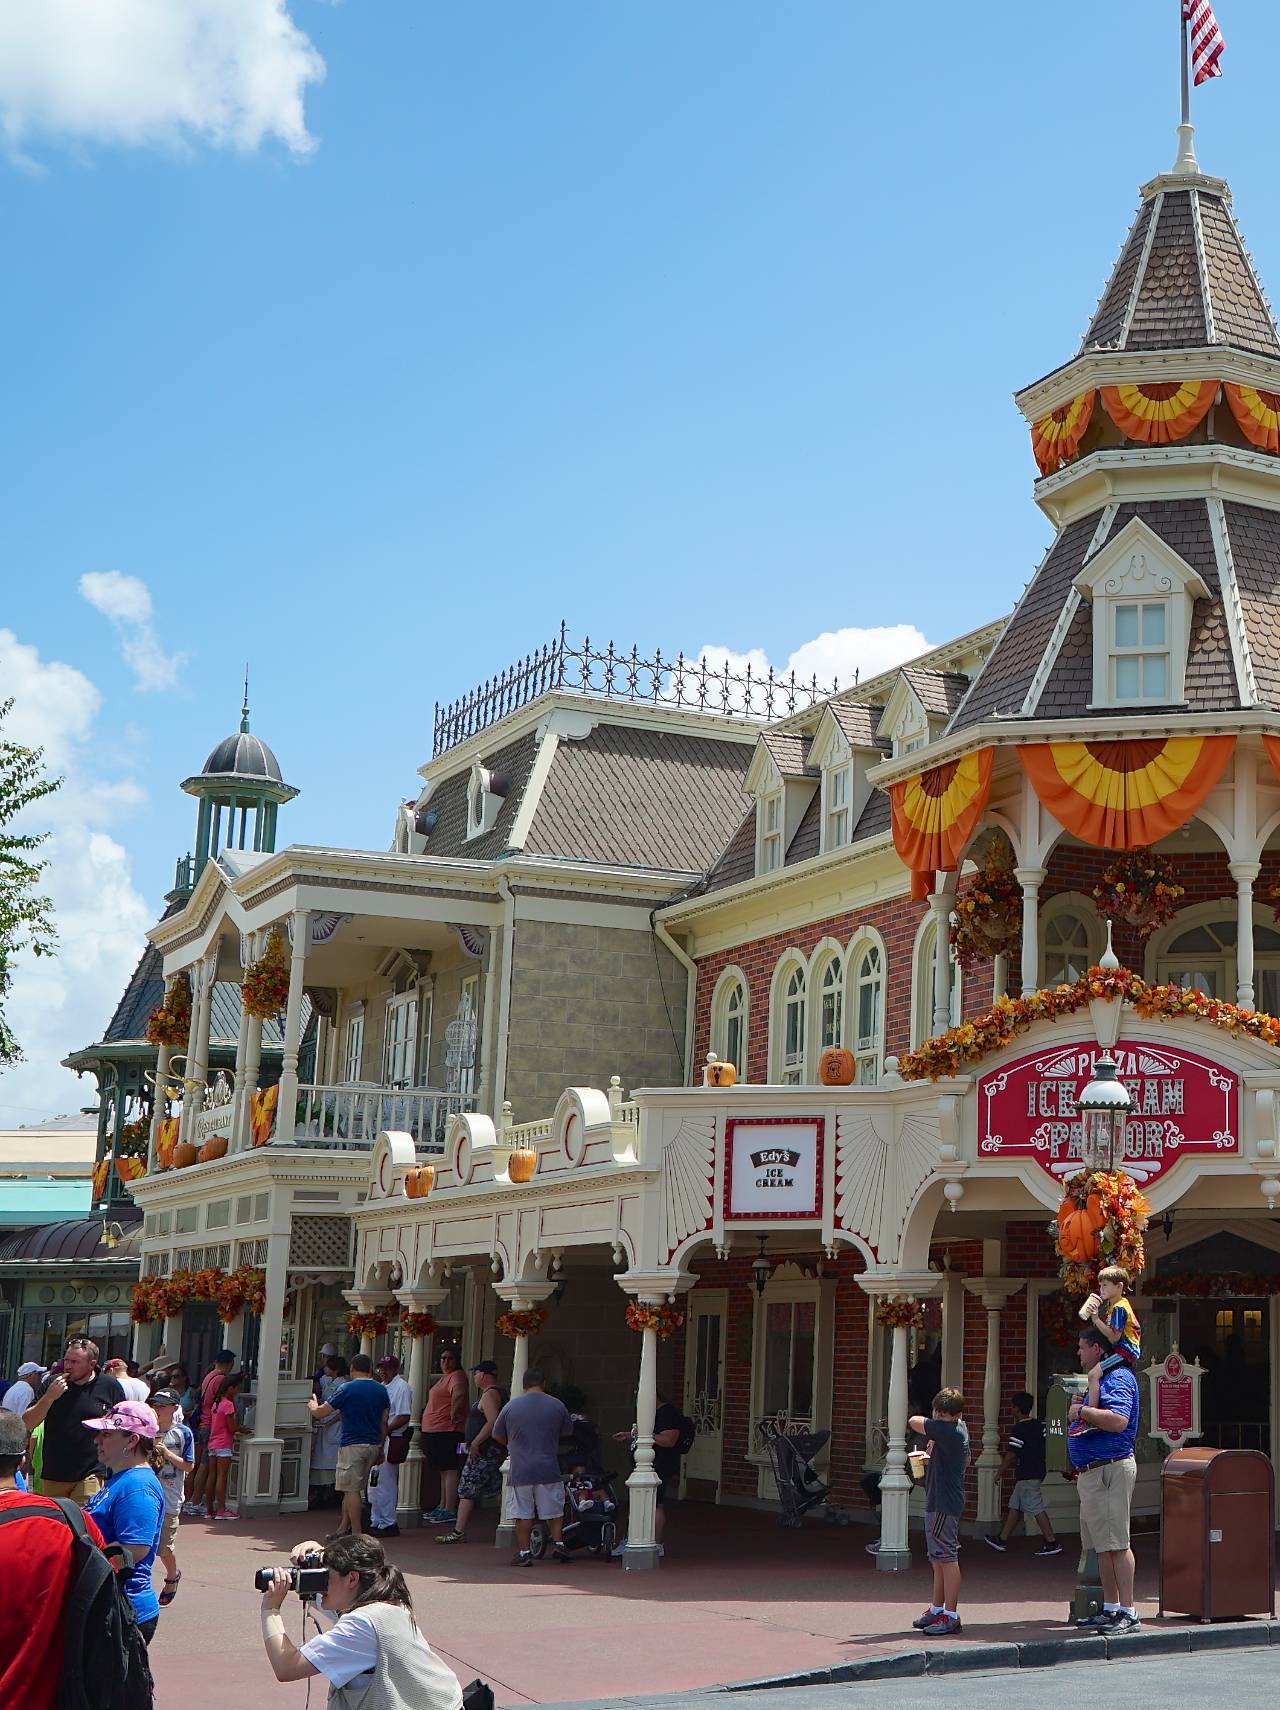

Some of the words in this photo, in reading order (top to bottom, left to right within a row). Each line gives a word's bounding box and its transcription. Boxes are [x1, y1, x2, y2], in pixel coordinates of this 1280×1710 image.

[1078, 1051, 1138, 1076] PLZA
[1027, 1081, 1077, 1117] ICE
[1083, 1078, 1185, 1116] EAM
[1050, 1120, 1165, 1158] PAOR
[760, 1151, 790, 1163] Edy's
[766, 1169, 784, 1177] ICE
[755, 1179, 794, 1187] CREAM
[1050, 1427, 1064, 1436] MAIL
